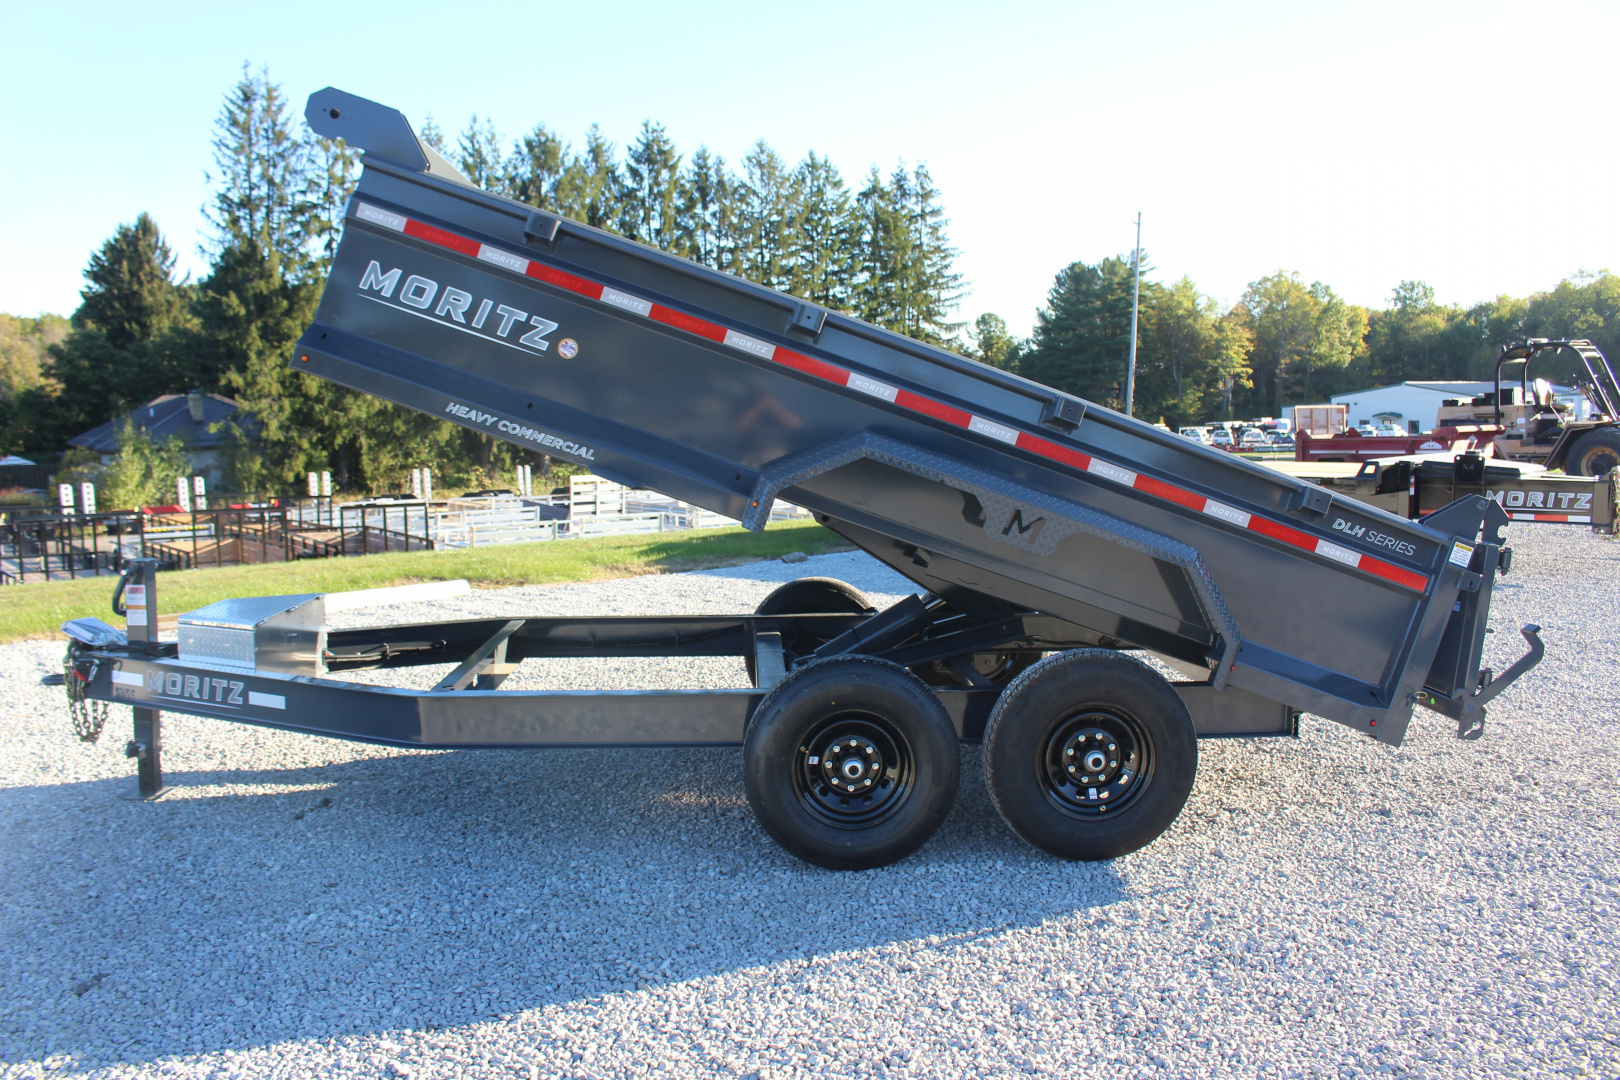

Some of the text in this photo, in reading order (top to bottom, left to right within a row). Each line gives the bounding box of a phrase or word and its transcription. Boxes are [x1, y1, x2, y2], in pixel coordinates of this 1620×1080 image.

[363, 209, 399, 226] MORITZ
[485, 251, 522, 268] MORITZ
[358, 259, 559, 351] MORITZ
[608, 293, 644, 311] MORITZ
[731, 336, 768, 353] MORITZ
[855, 379, 891, 397] MORITZ
[445, 402, 595, 461] HEAVY COMMERCIAL
[976, 422, 1012, 439] MORITZ
[1095, 464, 1130, 481] MORITZ
[1485, 490, 1593, 509] MORITZ
[1210, 505, 1244, 521] MORITZ
[1332, 518, 1416, 556] DLH SERIES
[1322, 546, 1355, 562] MORITZ
[146, 670, 245, 705] MORITZ
